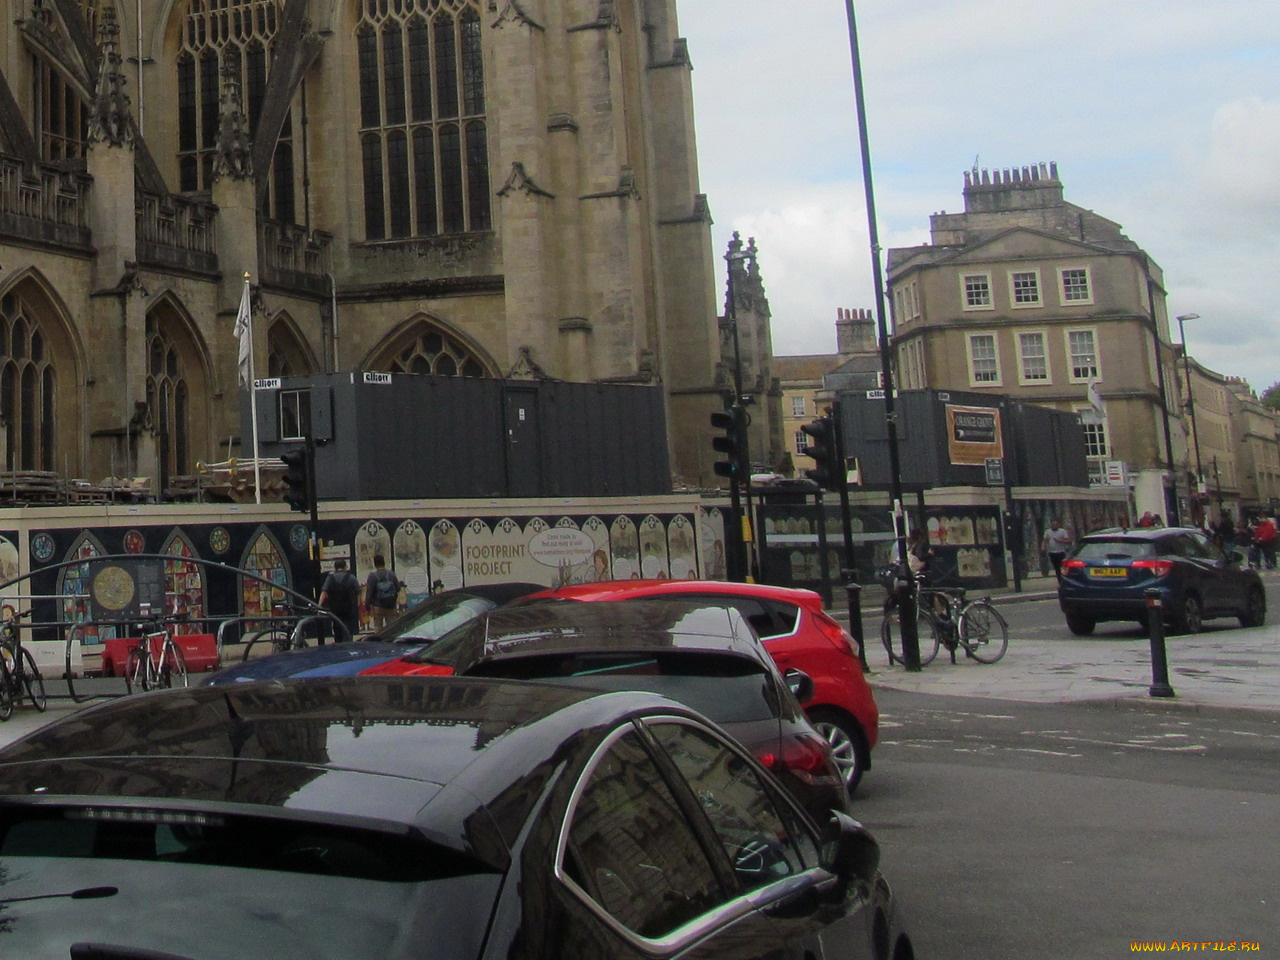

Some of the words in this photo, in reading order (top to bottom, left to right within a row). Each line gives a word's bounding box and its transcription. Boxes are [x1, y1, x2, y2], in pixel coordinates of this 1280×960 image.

[253, 379, 278, 388] elliott
[365, 374, 389, 382] elliott
[466, 544, 526, 560] FOOTPRINT
[467, 561, 512, 576] PROJECT
